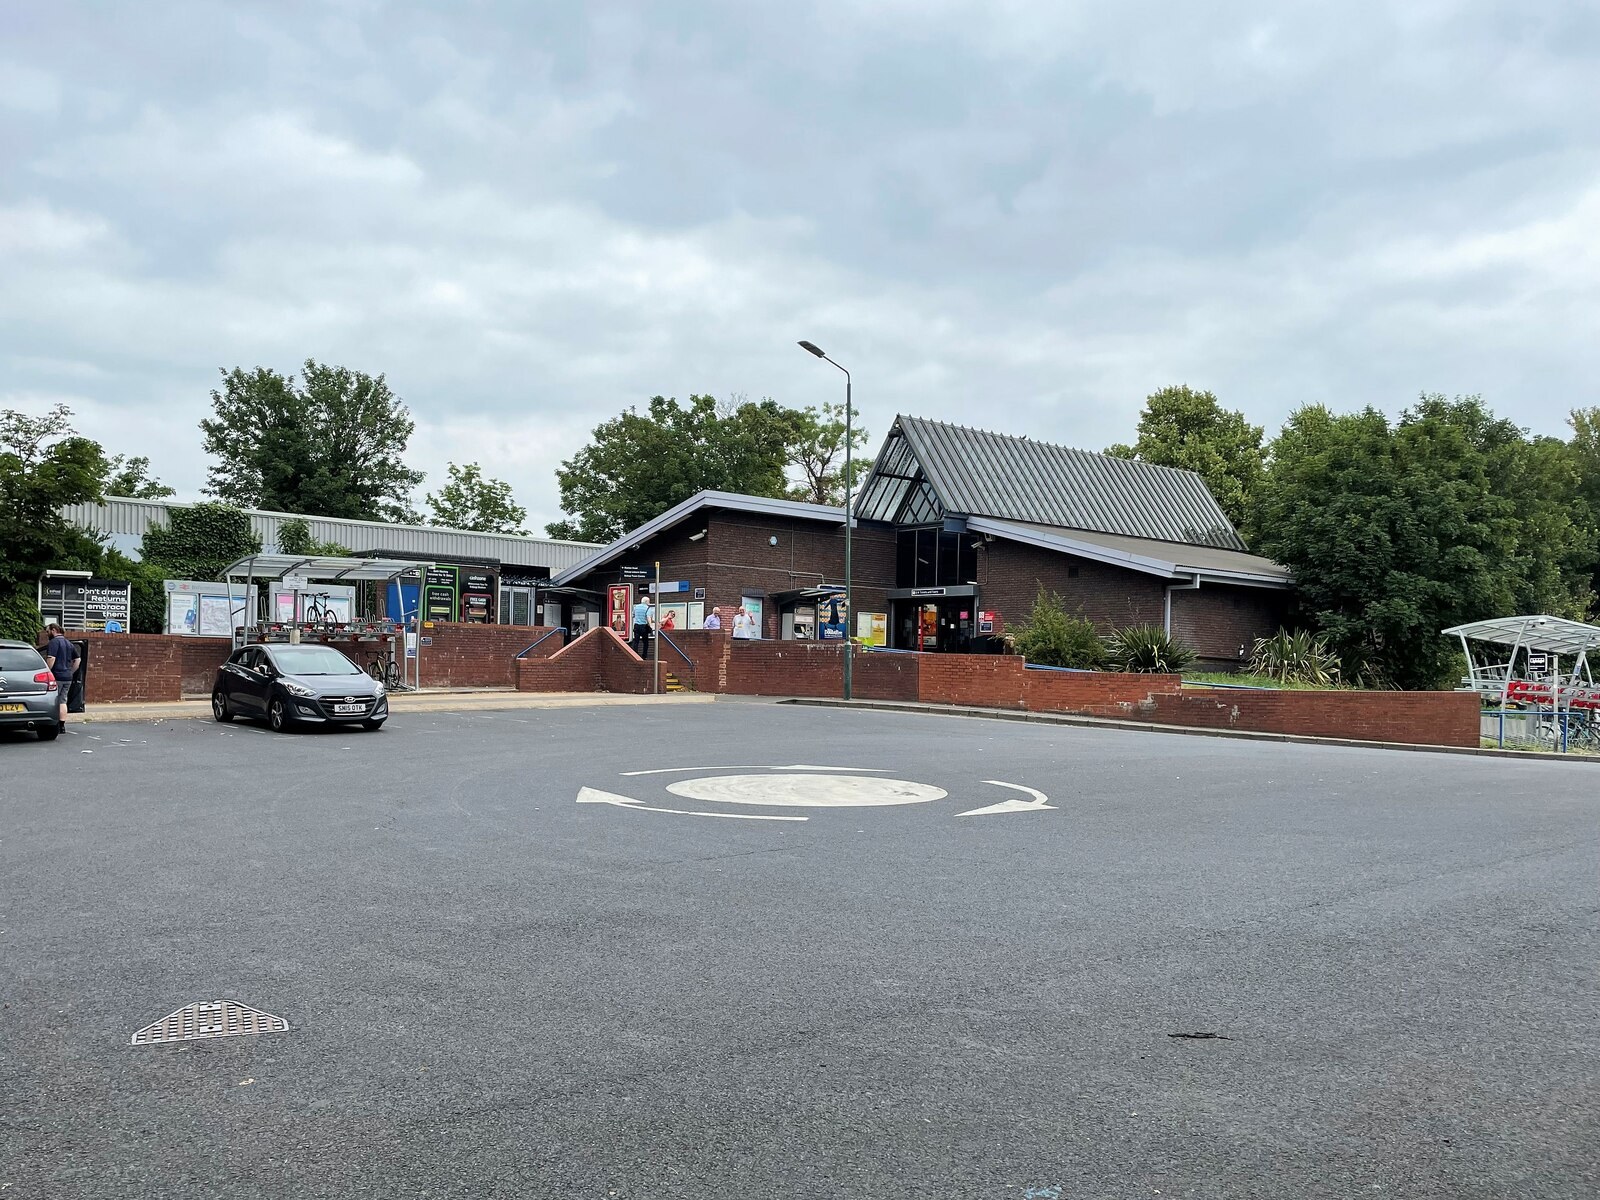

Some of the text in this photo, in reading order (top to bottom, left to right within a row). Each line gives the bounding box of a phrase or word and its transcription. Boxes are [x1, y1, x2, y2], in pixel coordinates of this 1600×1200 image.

[78, 587, 127, 596] Don't dread
[87, 603, 126, 611] embrace
[102, 610, 127, 618] them.
